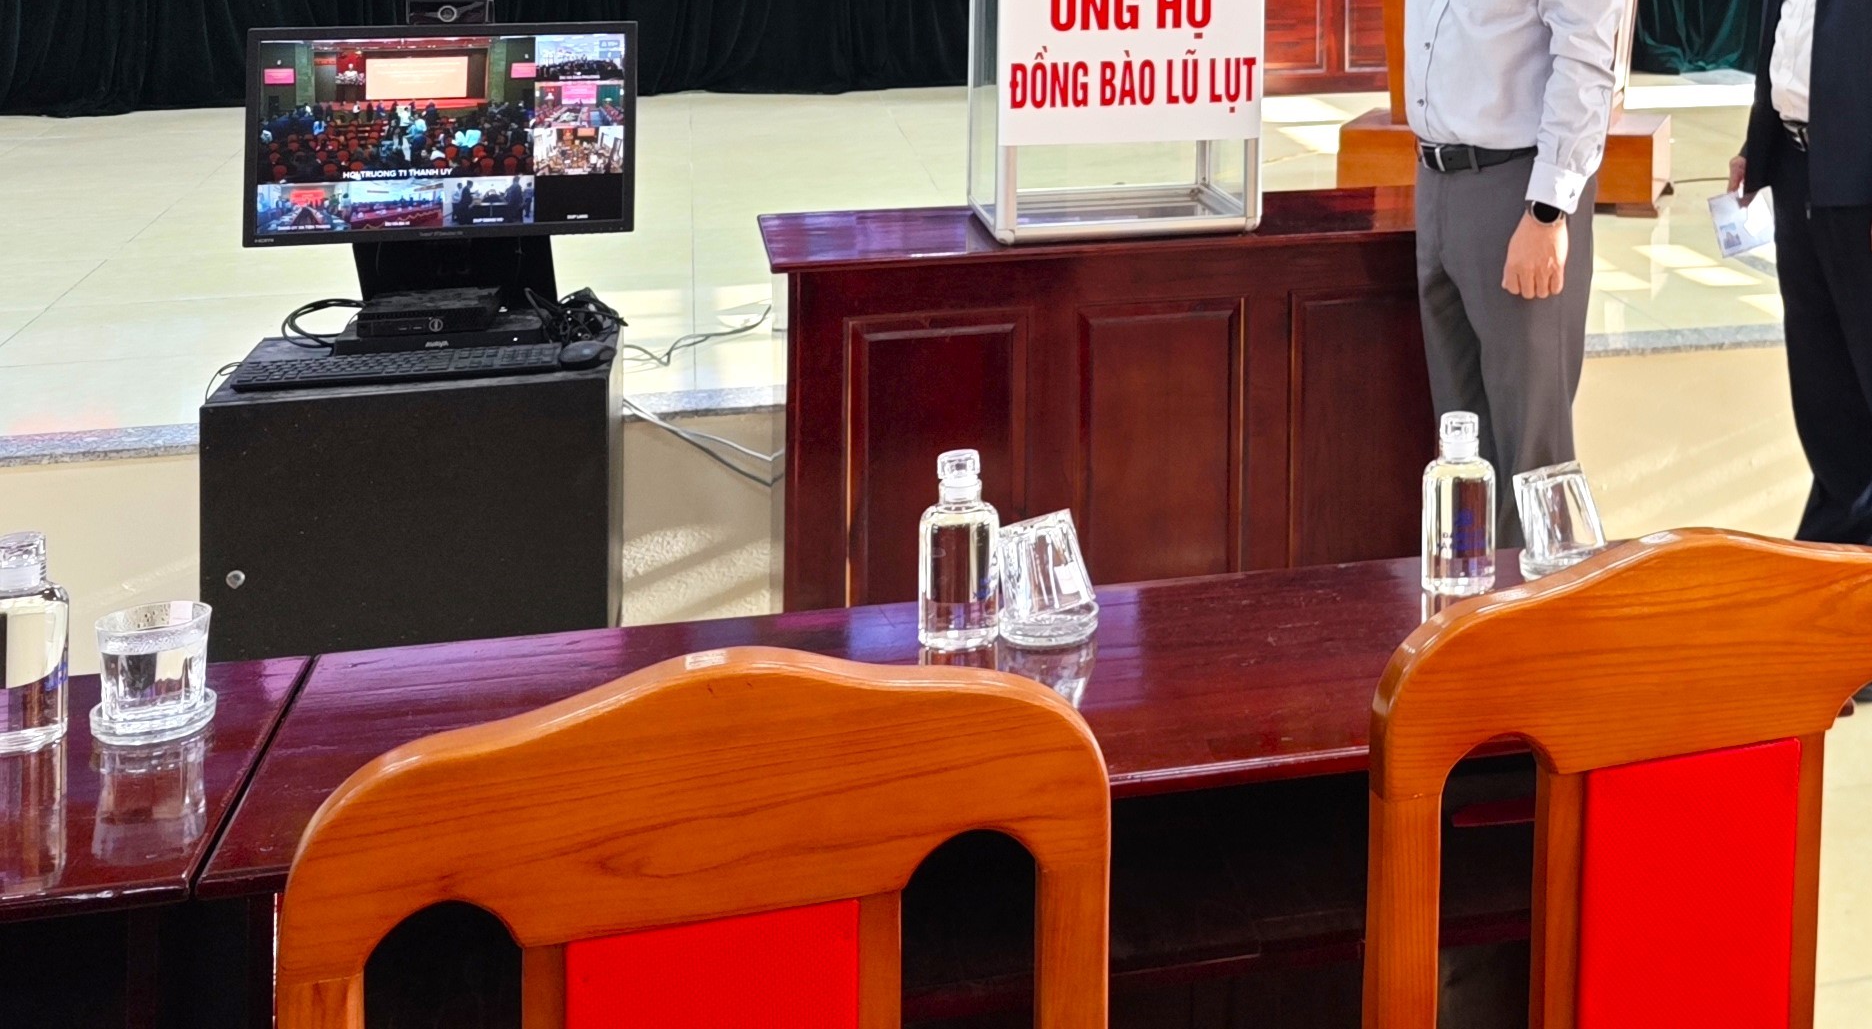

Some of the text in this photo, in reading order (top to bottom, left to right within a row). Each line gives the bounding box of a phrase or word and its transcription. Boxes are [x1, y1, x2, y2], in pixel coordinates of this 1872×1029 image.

[1009, 45, 1257, 114] ĐỒNG BÀO LŨ LỤT
[361, 170, 397, 178] TRUONG
[408, 168, 439, 177] THANH
[440, 167, 453, 176] UY
